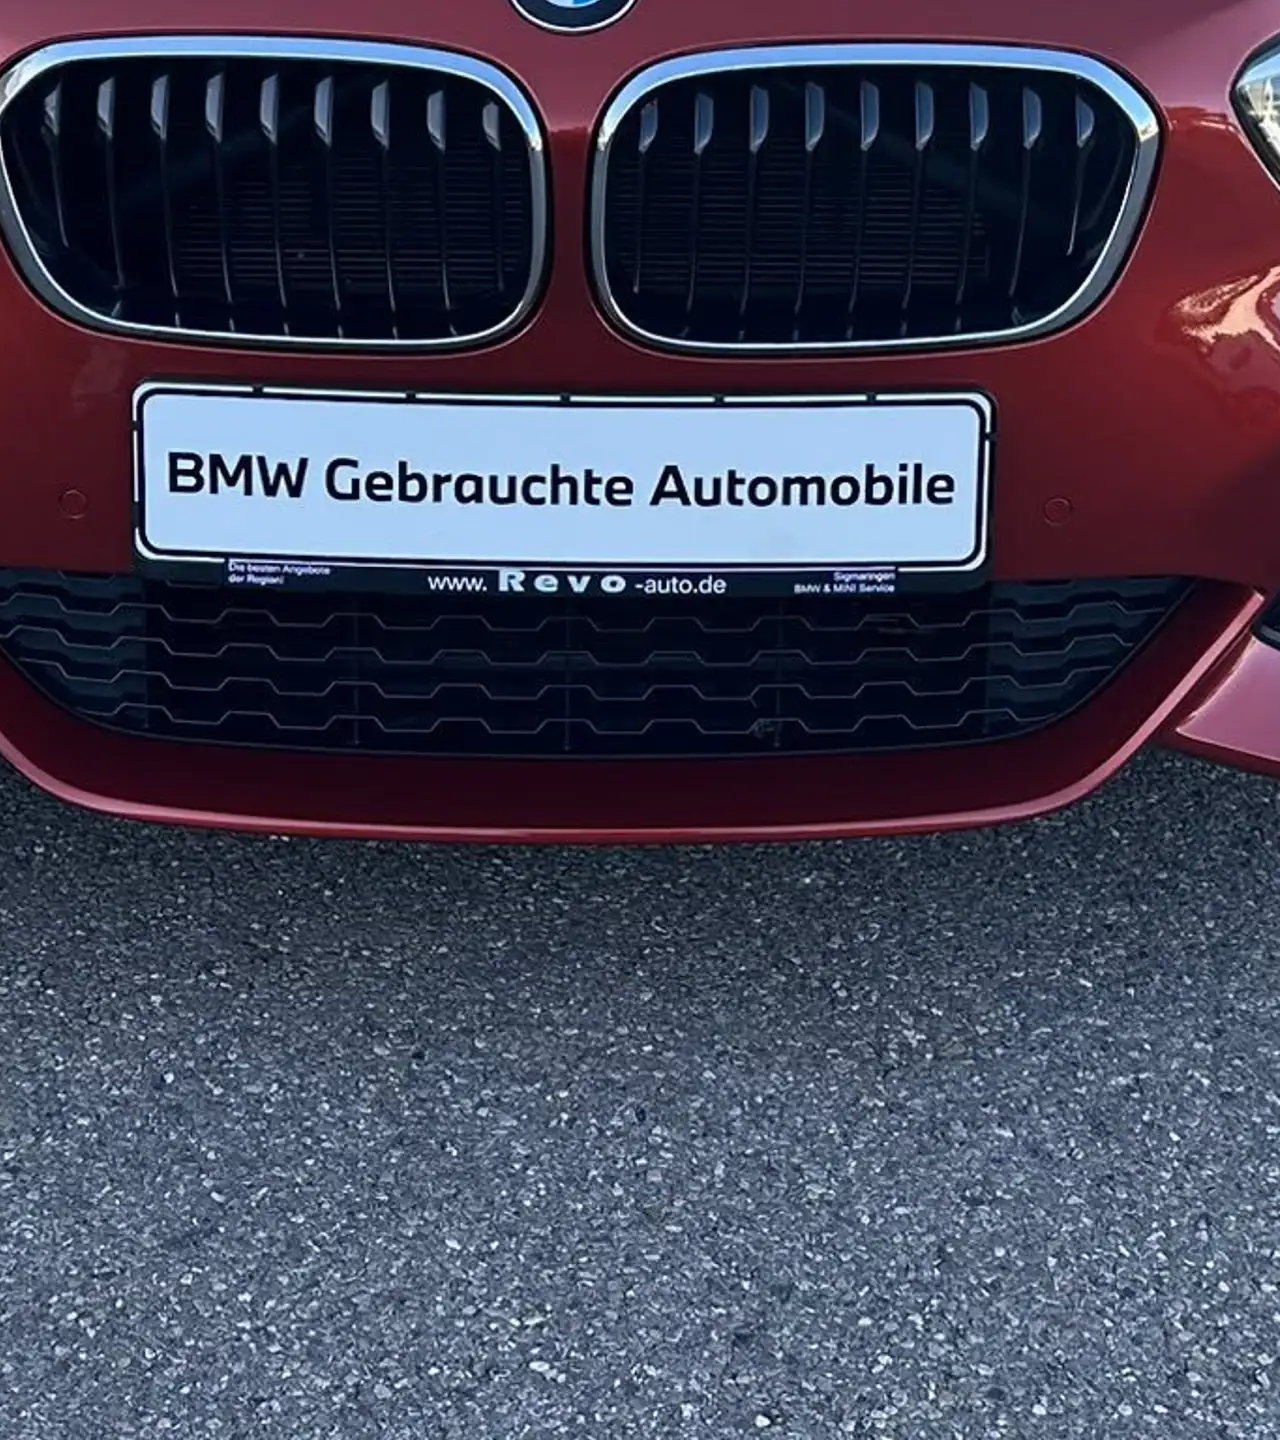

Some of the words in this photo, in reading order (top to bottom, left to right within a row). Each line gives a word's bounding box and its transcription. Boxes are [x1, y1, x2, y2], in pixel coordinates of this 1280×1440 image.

[167, 451, 310, 498] BMW
[324, 457, 634, 506] Gebrauchte
[648, 462, 956, 507] Automobile
